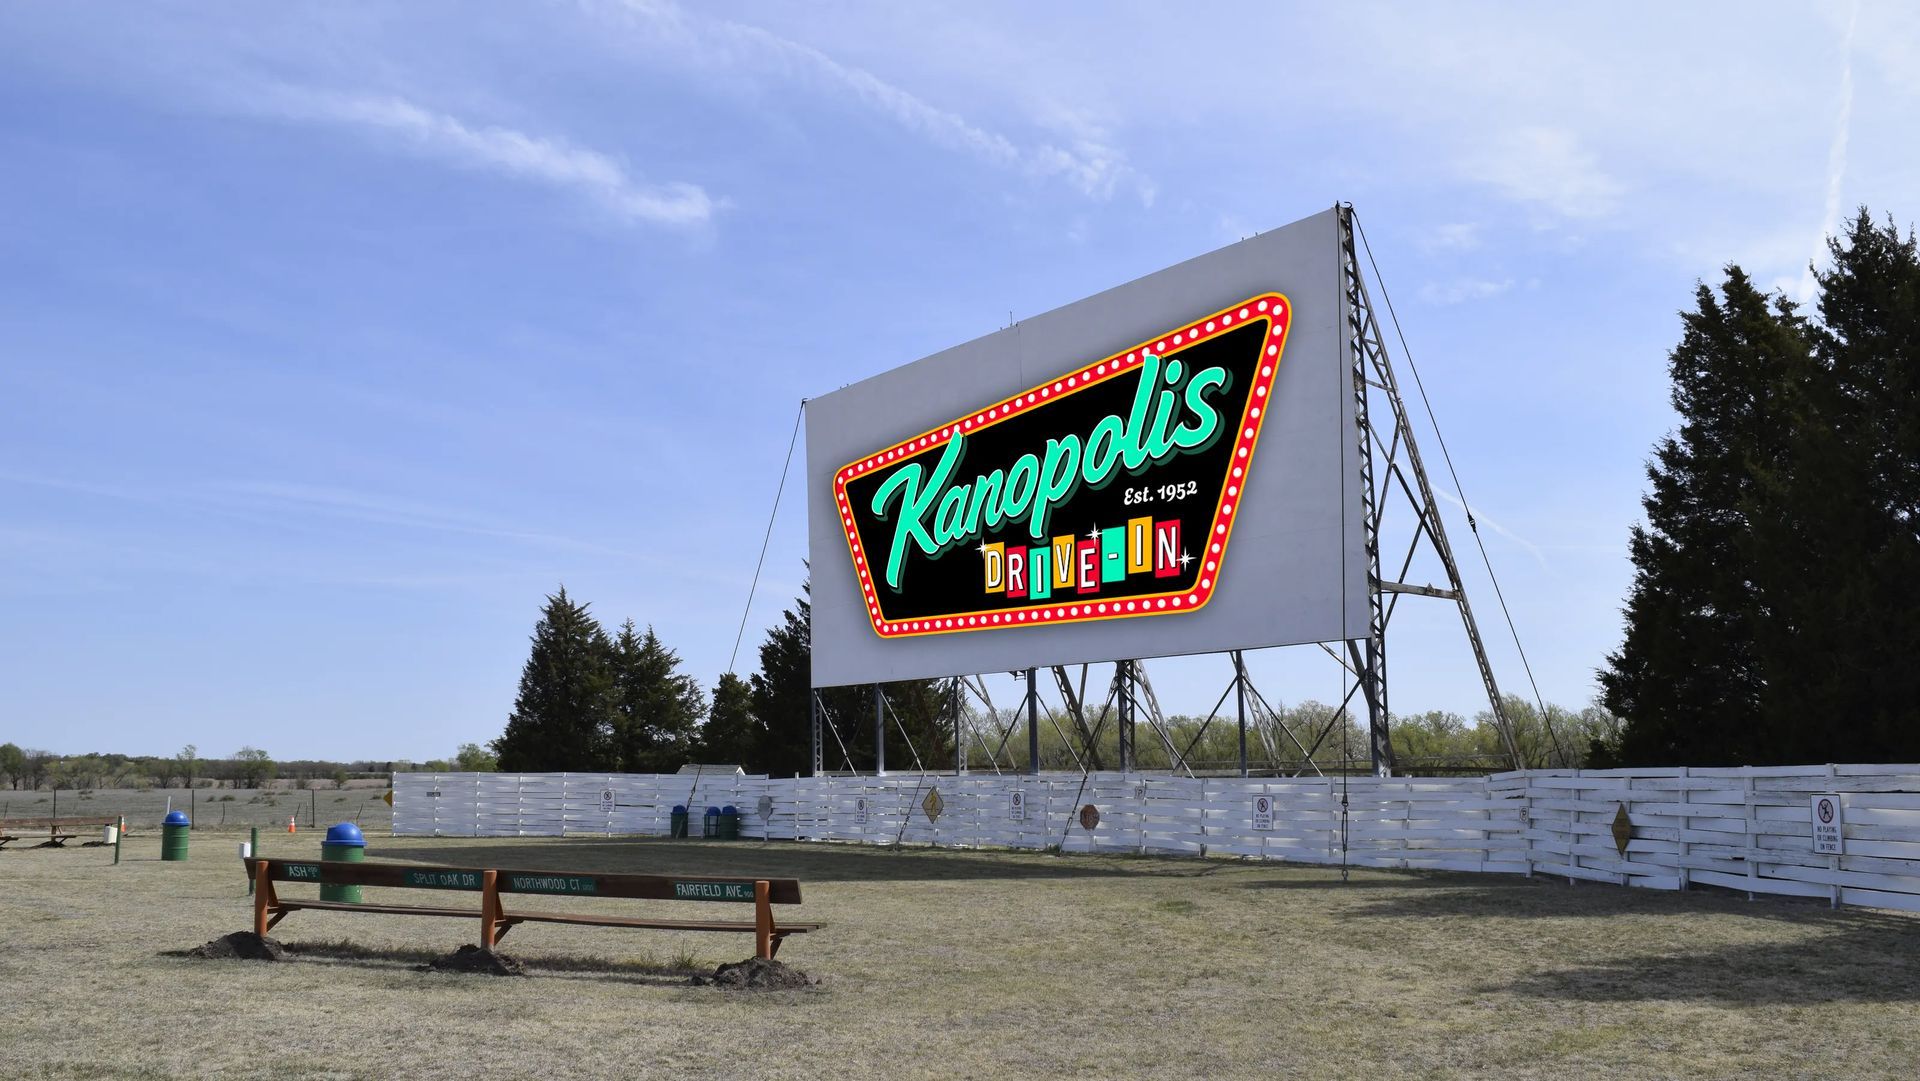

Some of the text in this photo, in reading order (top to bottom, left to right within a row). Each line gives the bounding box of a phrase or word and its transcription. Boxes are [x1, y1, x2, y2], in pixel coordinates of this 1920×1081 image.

[871, 354, 1227, 588] Kanopolis
[1123, 480, 1198, 506] Est. 1952
[986, 524, 1177, 594] DRIVE-IN
[288, 866, 308, 878] ASH
[413, 872, 475, 886] SPLIT OAK DR
[513, 877, 567, 890] NORTHWOOD
[569, 878, 581, 891] CT
[676, 883, 721, 897] FAIRFIELD
[725, 885, 743, 898] AVE
